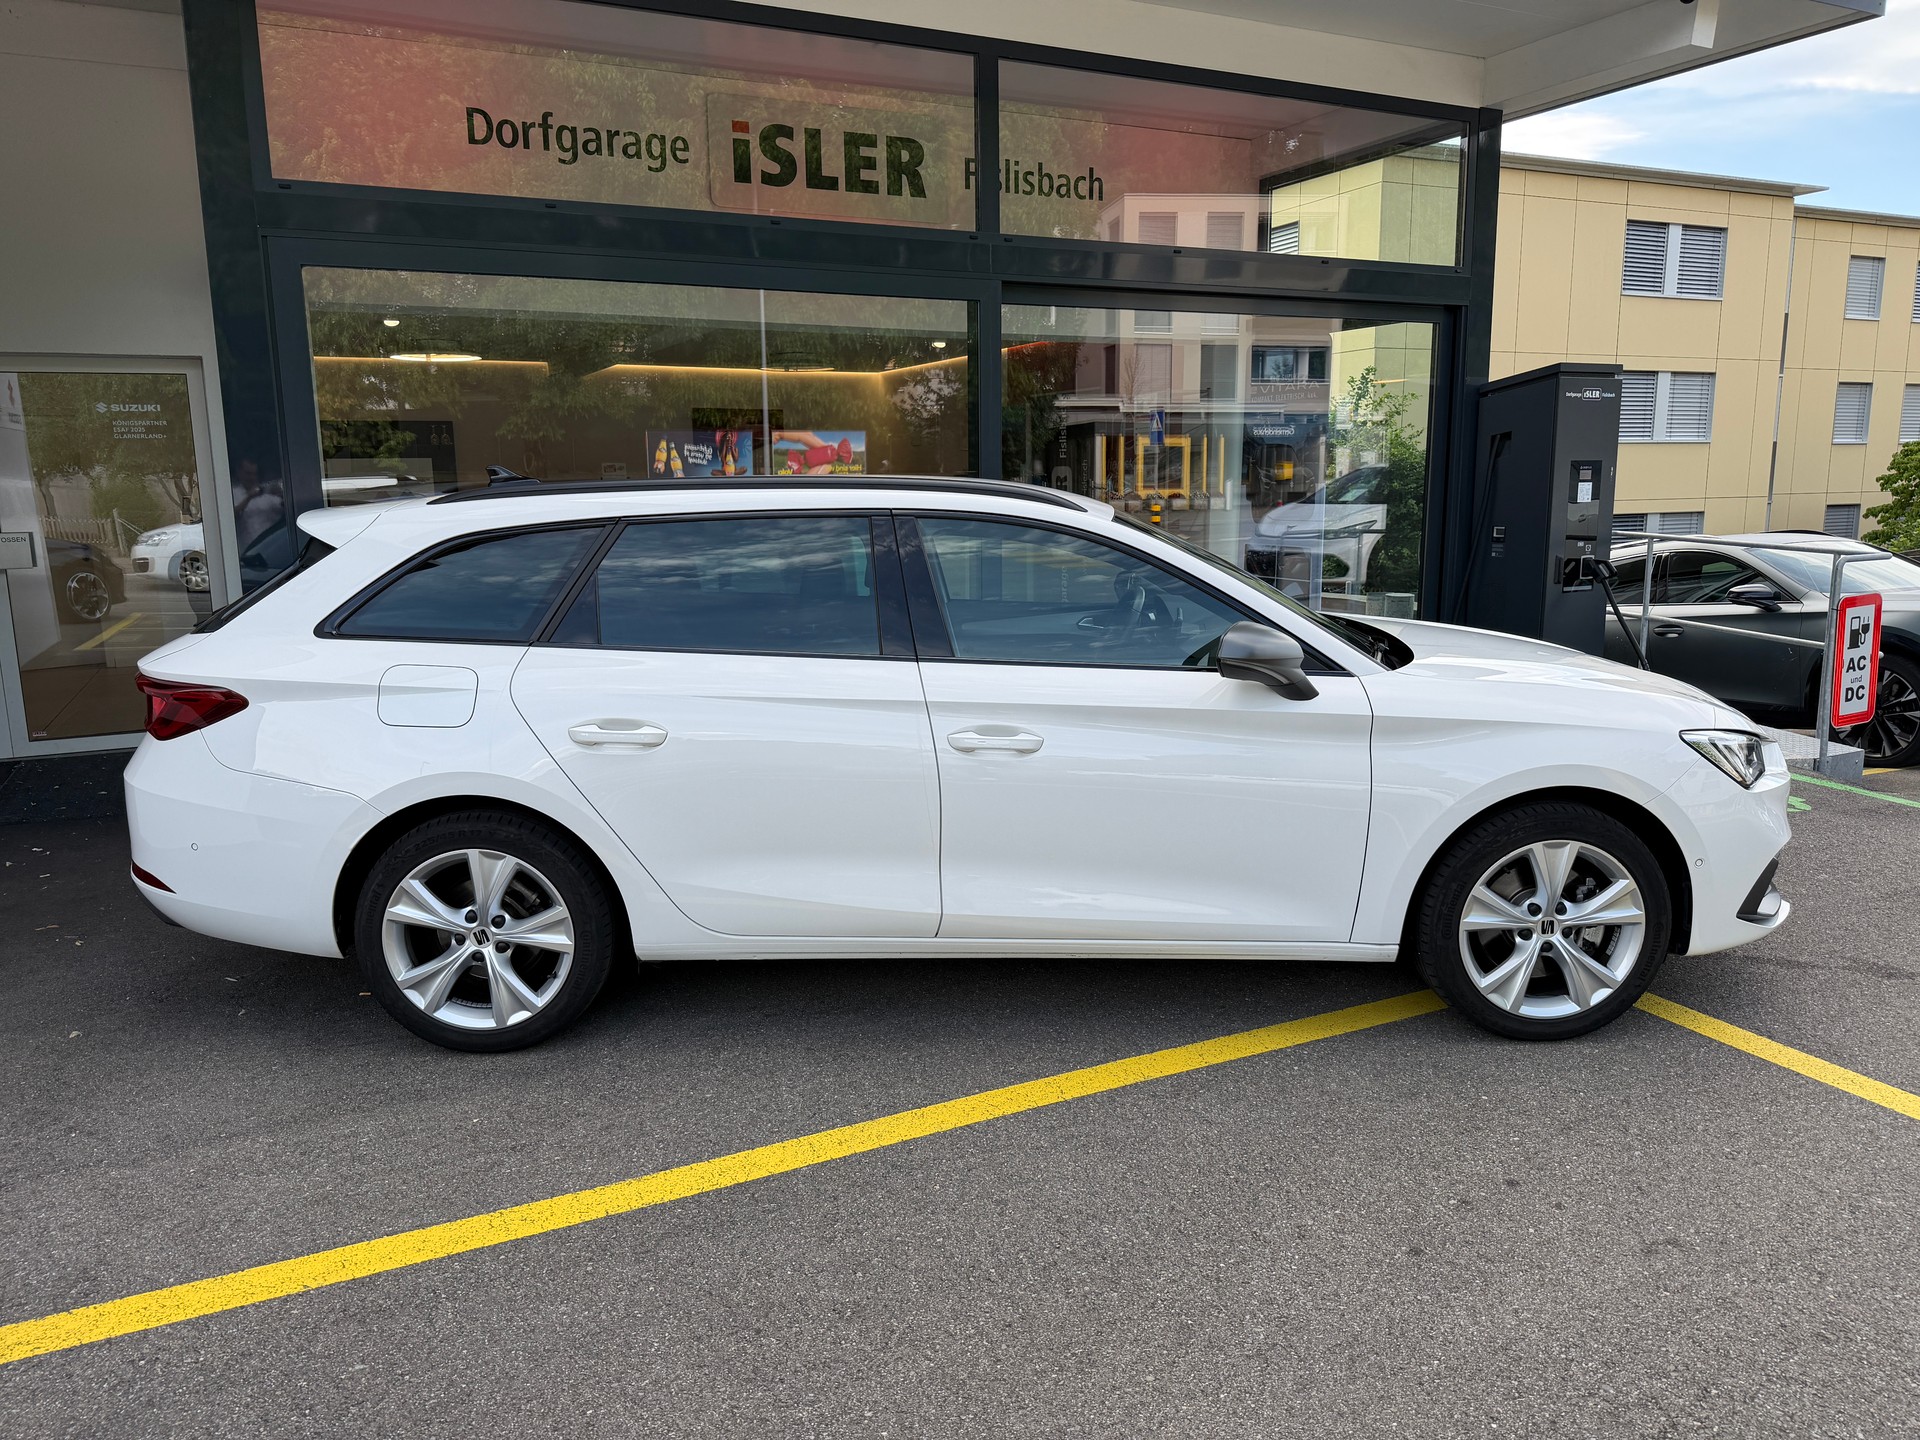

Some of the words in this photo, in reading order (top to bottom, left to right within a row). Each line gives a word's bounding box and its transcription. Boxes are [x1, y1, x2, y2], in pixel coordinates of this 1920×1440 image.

[466, 106, 690, 173] Dorfgarage
[964, 156, 1105, 202] Flisbach
[110, 404, 161, 412] SUZUKI
[1845, 655, 1867, 673] AC
[1850, 674, 1863, 684] und
[1844, 684, 1866, 703] DC
